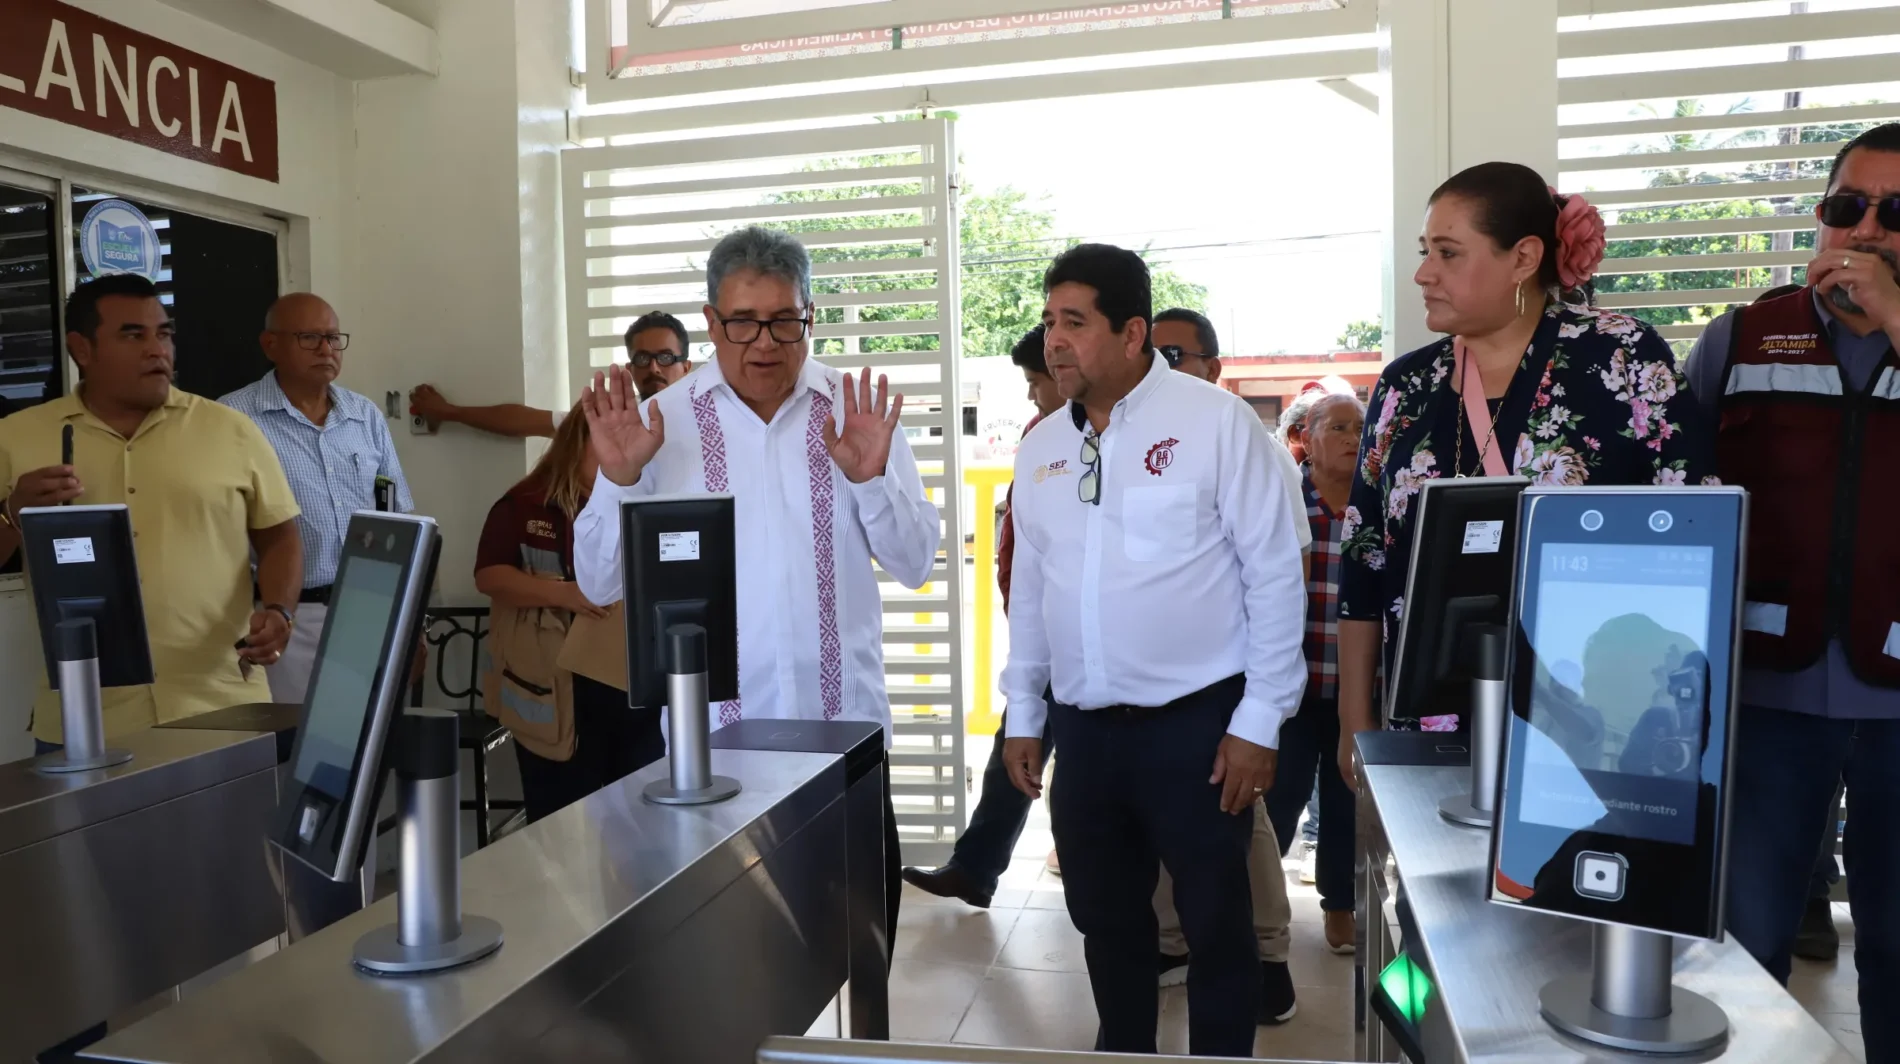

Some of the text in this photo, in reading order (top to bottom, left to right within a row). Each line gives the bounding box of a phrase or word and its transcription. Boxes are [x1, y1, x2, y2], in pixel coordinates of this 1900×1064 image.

[104, 250, 139, 262] SEGURA
[1758, 340, 1816, 350] ALTAMIRA
[1049, 459, 1067, 470] SEP
[1552, 555, 1588, 572] 11:43
[1643, 804, 1678, 816] rostro
